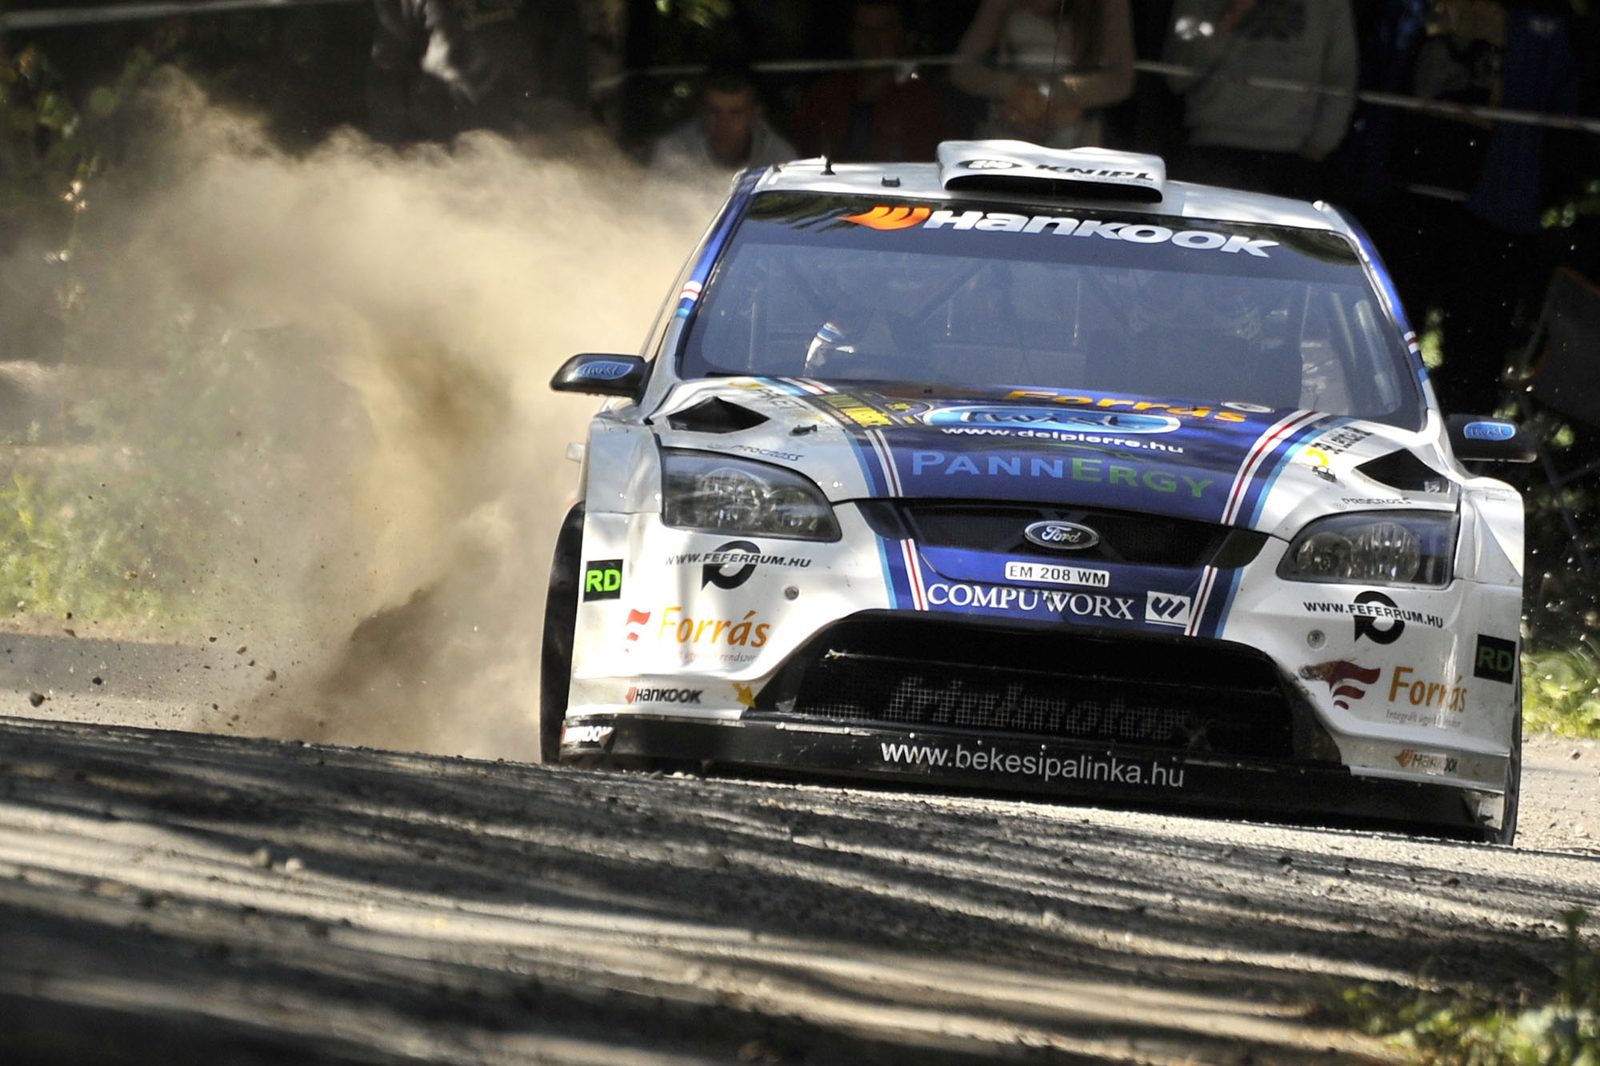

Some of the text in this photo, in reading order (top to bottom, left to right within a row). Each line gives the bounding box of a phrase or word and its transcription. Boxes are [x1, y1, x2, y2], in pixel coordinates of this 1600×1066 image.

[1034, 164, 1155, 182] KNIPL
[1041, 525, 1082, 543] Ford
[665, 551, 811, 569] WWW.FEFERRUM.HU
[586, 568, 622, 593] RD
[1009, 564, 1107, 586] EM 208 WM
[657, 606, 771, 648] Forrás
[1303, 601, 1444, 629] WWW.FEFERRUM.HU
[1478, 646, 1513, 672] RD
[1388, 666, 1468, 713] Forrás
[880, 741, 1186, 789] www.bekesipalinka.hu
